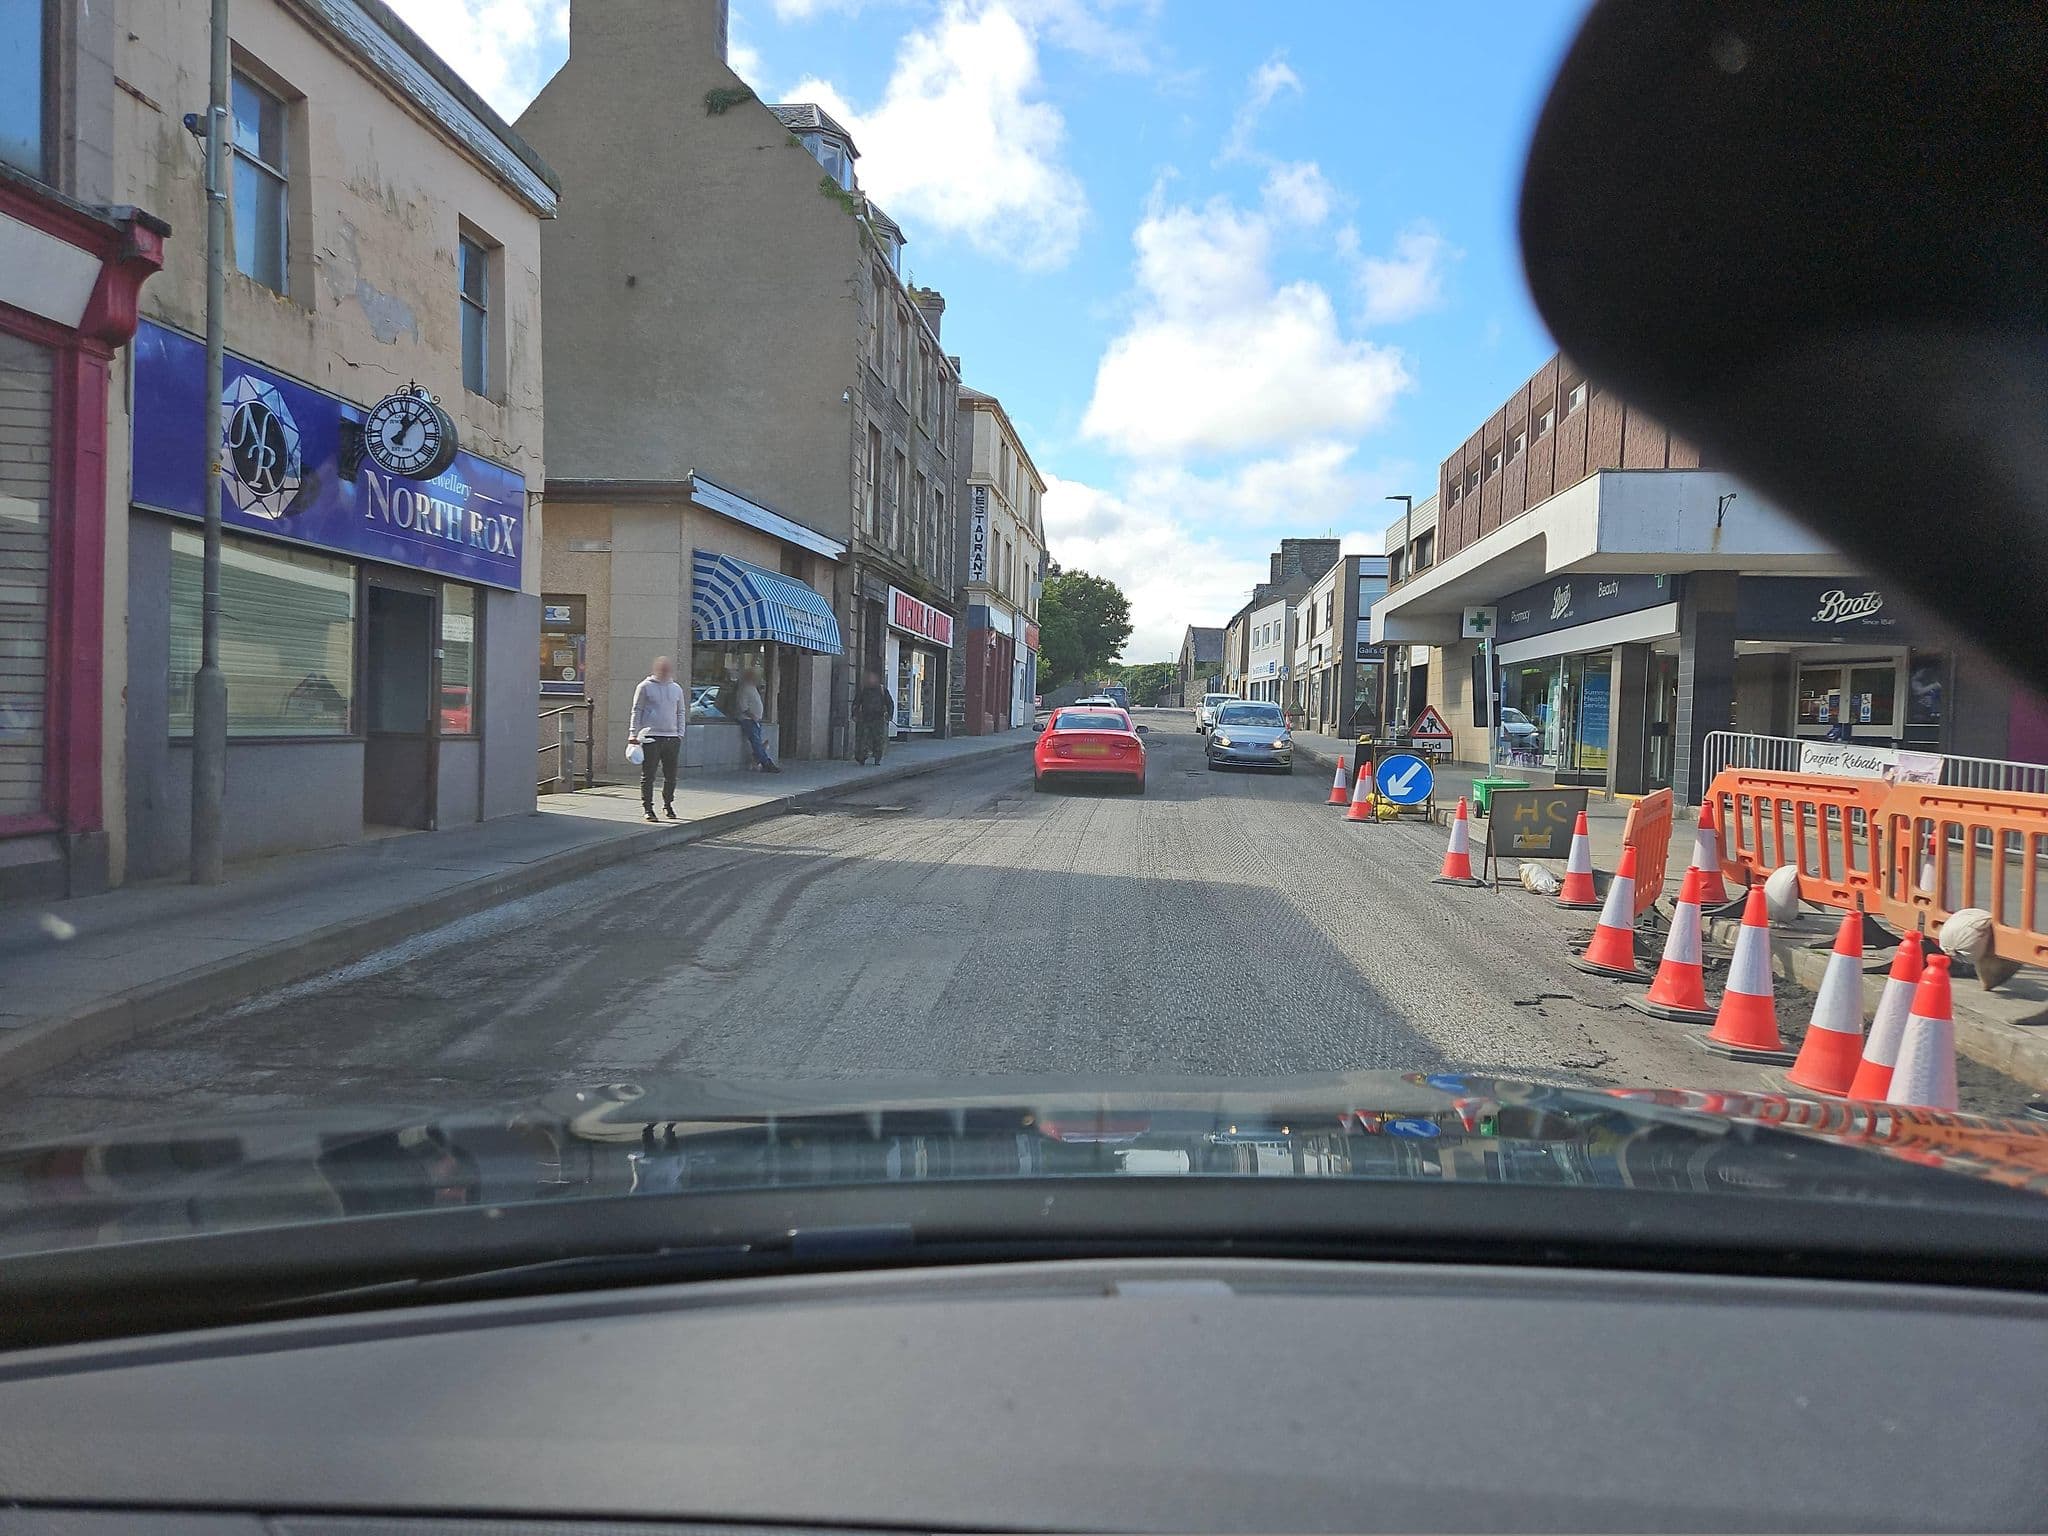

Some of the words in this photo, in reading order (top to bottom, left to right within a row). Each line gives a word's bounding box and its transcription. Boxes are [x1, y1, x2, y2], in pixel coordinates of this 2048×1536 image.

[364, 469, 465, 544] NORTH
[469, 510, 517, 558] ROX
[973, 486, 985, 580] RESTAURANT
[1550, 583, 1572, 620] Boots
[1598, 580, 1620, 598] Beauty
[1811, 589, 1883, 624] Boots
[1510, 609, 1531, 624] Pharmacy
[1422, 741, 1441, 750] End
